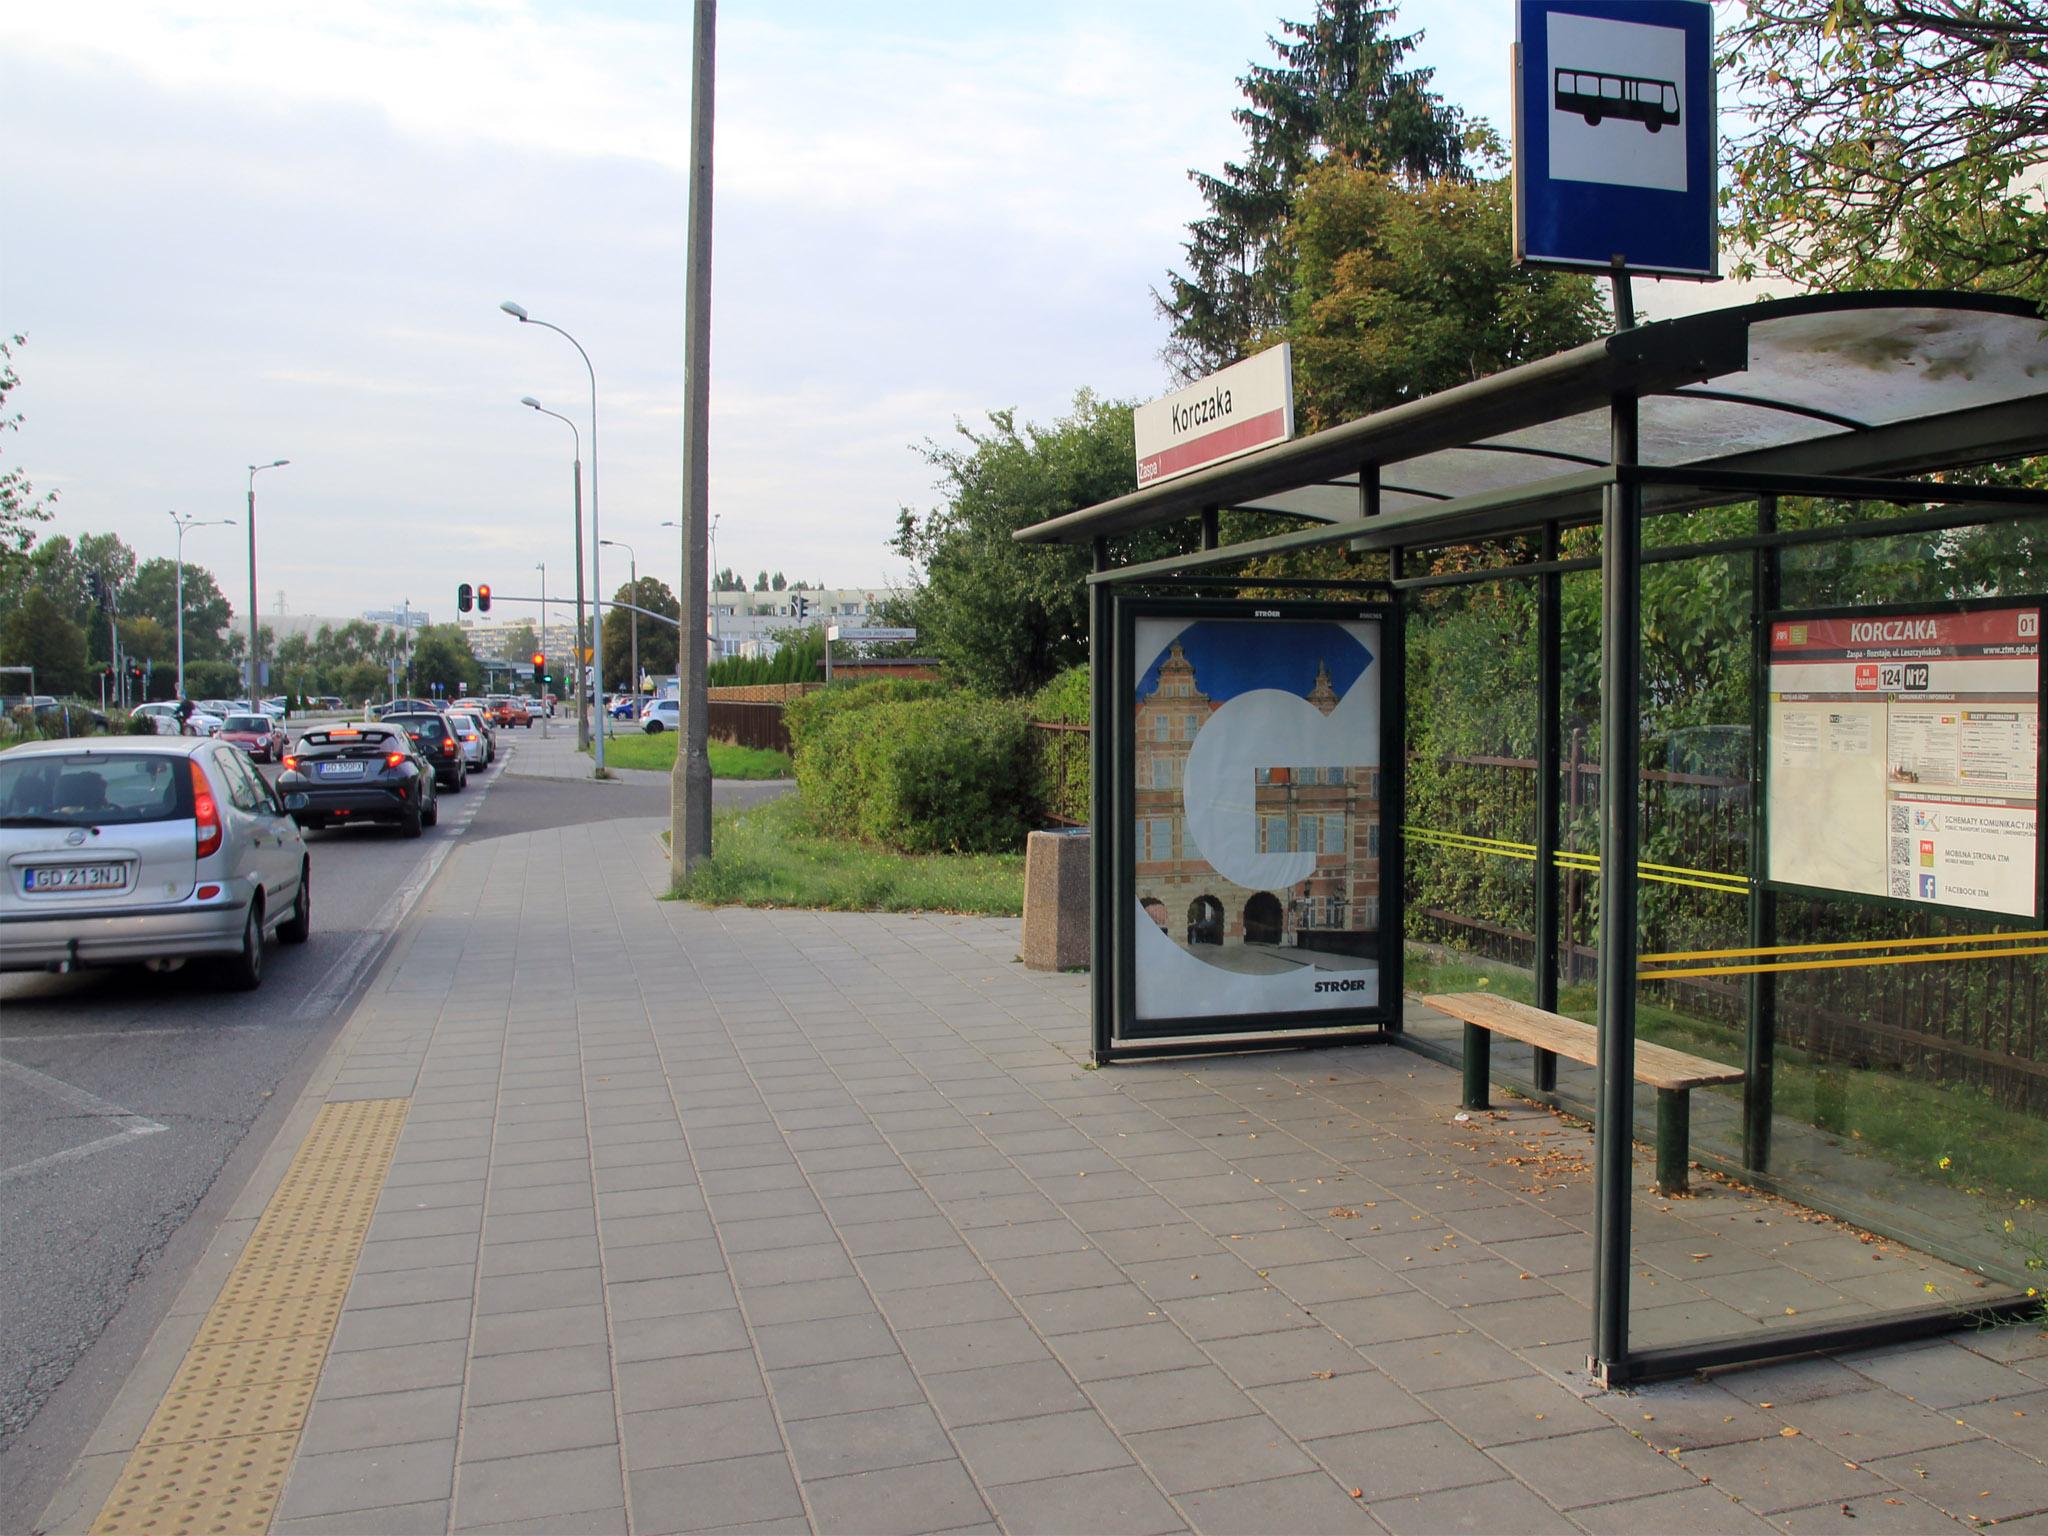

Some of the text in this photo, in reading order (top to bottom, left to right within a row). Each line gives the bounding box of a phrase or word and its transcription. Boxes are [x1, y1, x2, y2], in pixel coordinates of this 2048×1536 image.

[1172, 386, 1232, 435] Korczaka
[1138, 461, 1158, 481] Zaspa
[1254, 610, 1281, 618] STRÖER
[1850, 619, 1938, 642] KORCZAKA
[2020, 618, 2035, 632] 01
[1846, 650, 1863, 659] Zaspa
[1866, 648, 1892, 658] Rozstaje,
[1892, 648, 1900, 656] ul.
[1900, 647, 1941, 658] Leszczyńskich
[1983, 644, 2038, 656] www.ztm.gda.pl
[1881, 669, 1900, 686] 124
[1905, 668, 1927, 686] N12
[1944, 816, 1978, 826] SCHEMATY
[1944, 849, 2010, 863] MOBILNA STRONA ZTM
[36, 866, 120, 886] GD 213NJ
[1944, 885, 1989, 897] FACEBOOK ZTM
[1314, 979, 1366, 993] STRÖER
